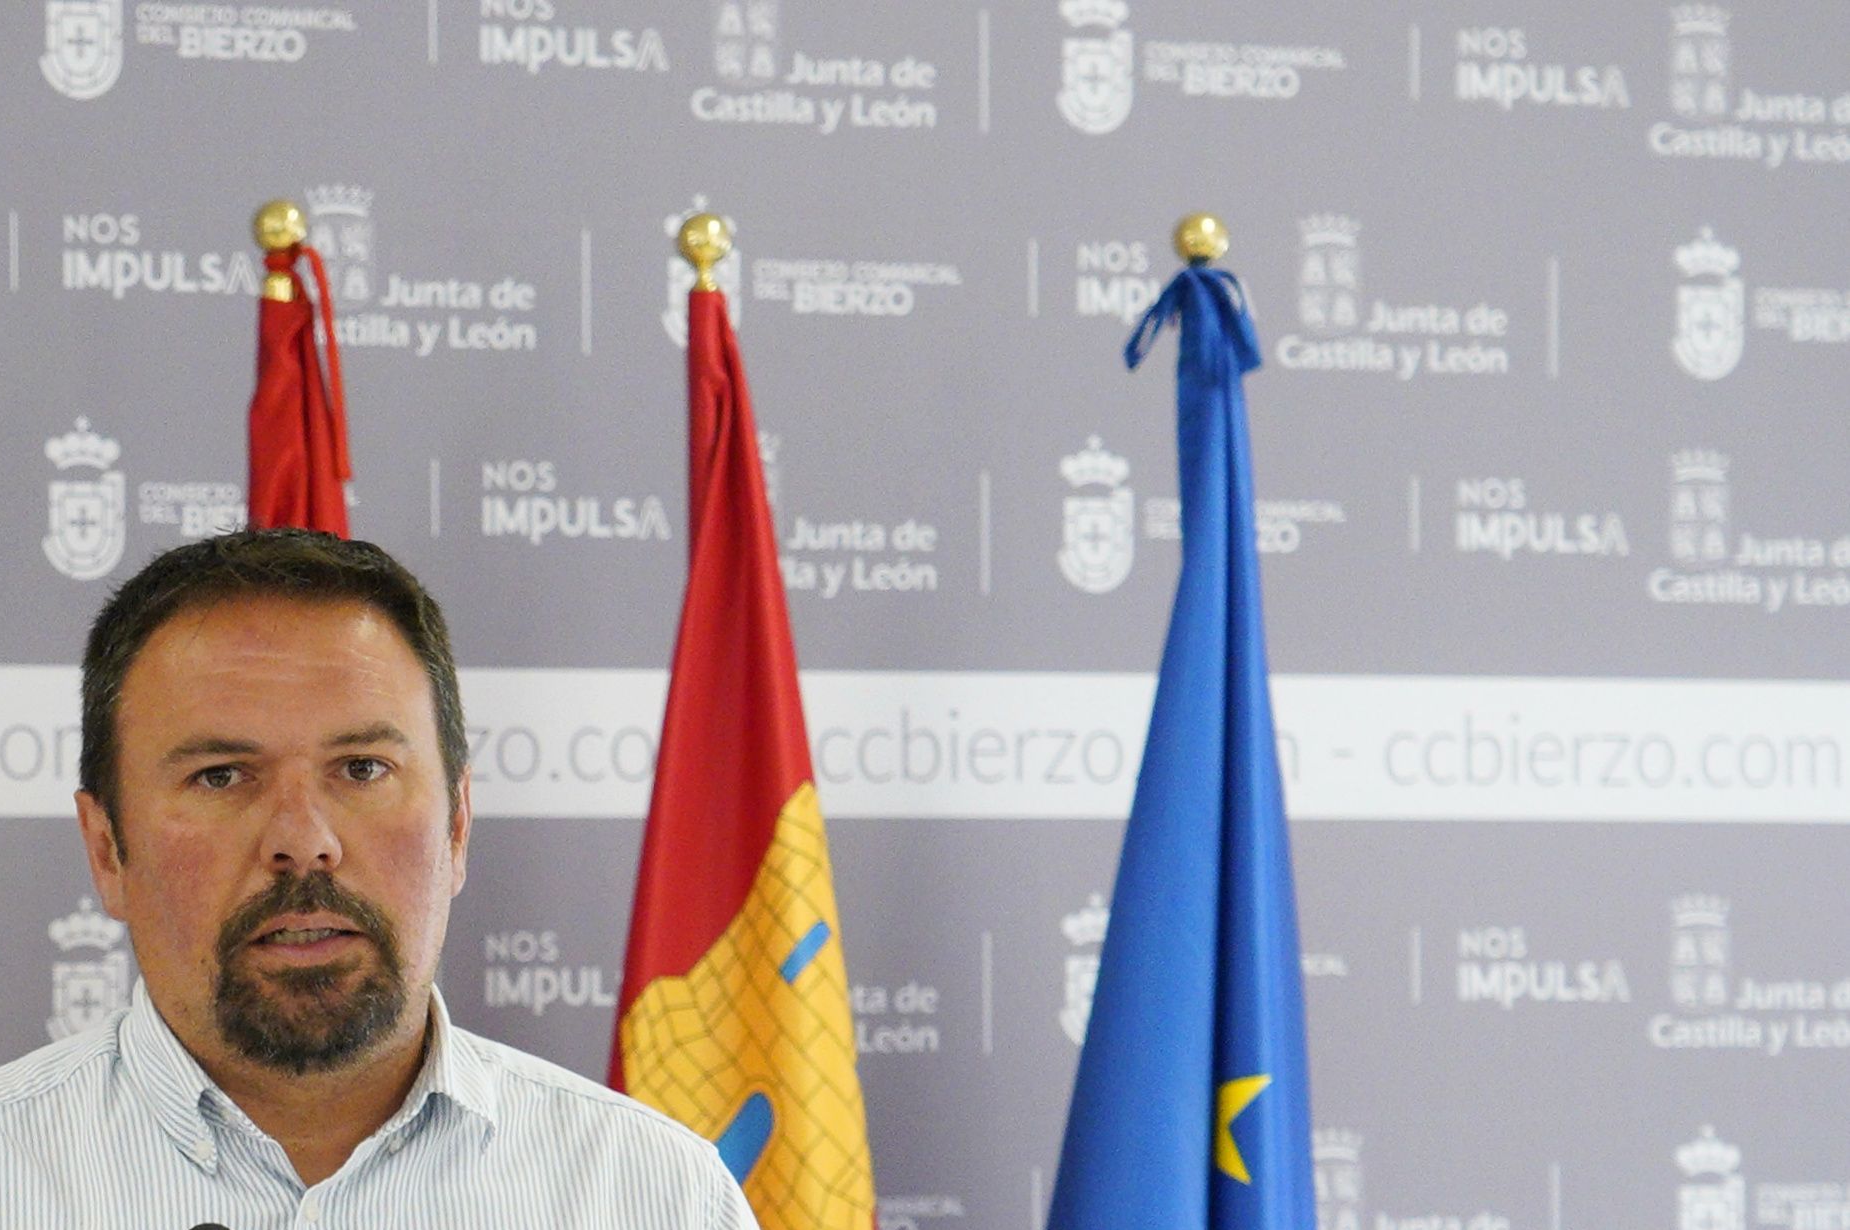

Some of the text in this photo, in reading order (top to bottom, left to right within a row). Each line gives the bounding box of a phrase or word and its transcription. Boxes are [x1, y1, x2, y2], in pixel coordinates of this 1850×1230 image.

[179, 28, 306, 63] BIERZO
[1458, 28, 1528, 60] NOS
[787, 54, 937, 89] Junta de
[1184, 66, 1301, 99] BIERZO
[692, 88, 937, 135] Castilla y León
[1737, 91, 1820, 127] Junta
[1649, 122, 1850, 168] Castilla y Leó
[64, 214, 141, 246] NOS
[1078, 242, 1150, 275] NOS
[382, 276, 536, 311] Junta de
[794, 282, 913, 316] BIERZO
[418, 324, 442, 357] y
[449, 317, 537, 351] León
[1368, 303, 1509, 337] Junta de
[1277, 334, 1509, 381] Castilla y León
[484, 461, 557, 493] NOS
[1458, 479, 1527, 510] NOS
[789, 519, 937, 552] Junta de
[1736, 536, 1820, 567] Junta
[824, 566, 846, 599] y
[853, 559, 938, 591] León
[1649, 570, 1850, 613] Castilla y Leó
[1383, 713, 1843, 790] ccbierzo.com
[487, 931, 561, 964] NOS
[1460, 928, 1528, 960] NOS
[896, 984, 940, 1014] de
[1738, 980, 1820, 1010] Junta
[856, 1021, 940, 1055] León
[1650, 1016, 1850, 1056] Castilla y Leó
